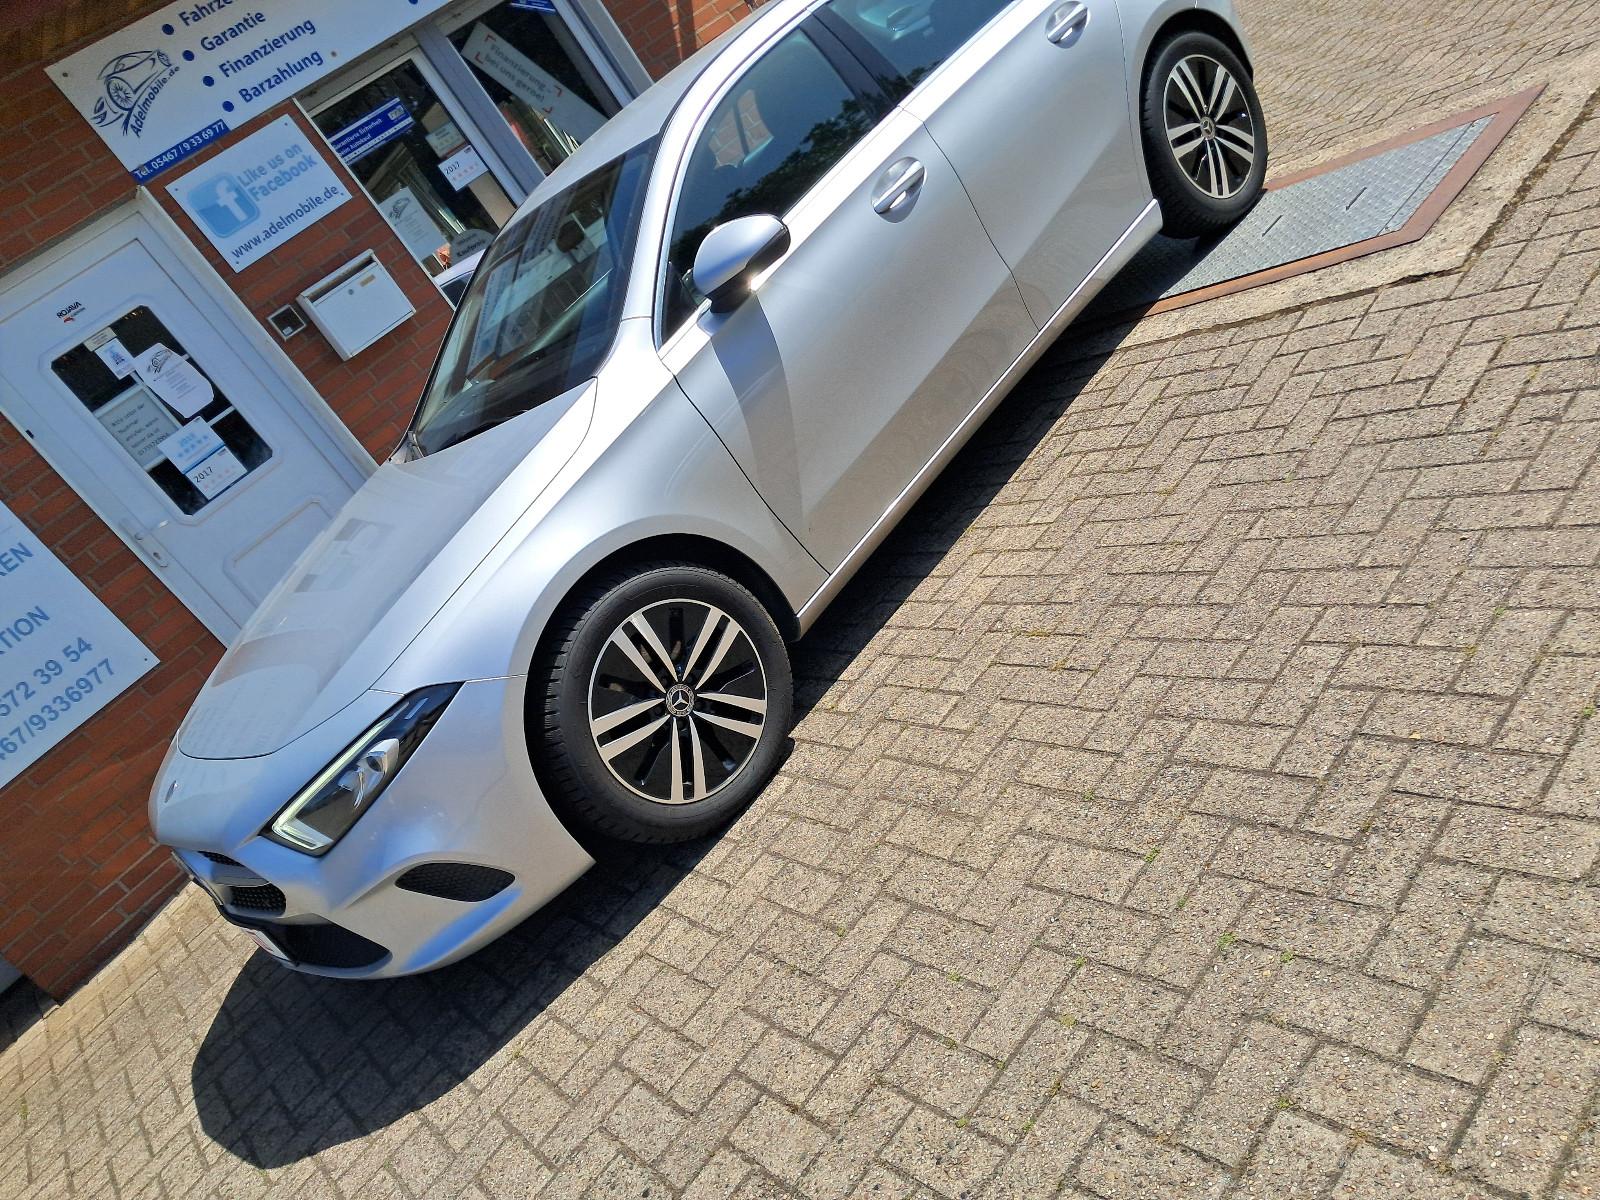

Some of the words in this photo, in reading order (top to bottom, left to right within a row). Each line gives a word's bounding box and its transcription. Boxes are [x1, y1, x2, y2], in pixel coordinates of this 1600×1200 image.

[200, 12, 266, 51] Garantie
[219, 20, 316, 77] Finanzierung
[130, 66, 180, 138] Adelmobile.de
[238, 51, 323, 103] Barzahlung
[134, 163, 153, 179] Tel.
[151, 149, 178, 169] 05467
[182, 142, 191, 152] 9
[191, 135, 203, 147] 33
[202, 128, 214, 140] 69
[214, 121, 226, 134] 77
[238, 165, 267, 187] Like
[267, 154, 285, 169] us
[285, 144, 303, 159] on
[445, 161, 460, 175] 2017
[248, 154, 317, 201] Facebook
[231, 185, 339, 258] www.adelmobile.de
[193, 466, 213, 483] 2017
[0, 541, 34, 577] EN
[0, 605, 51, 656] TION
[33, 659, 62, 685] 39
[62, 636, 93, 663] 54
[0, 658, 115, 761] 67/9336977
